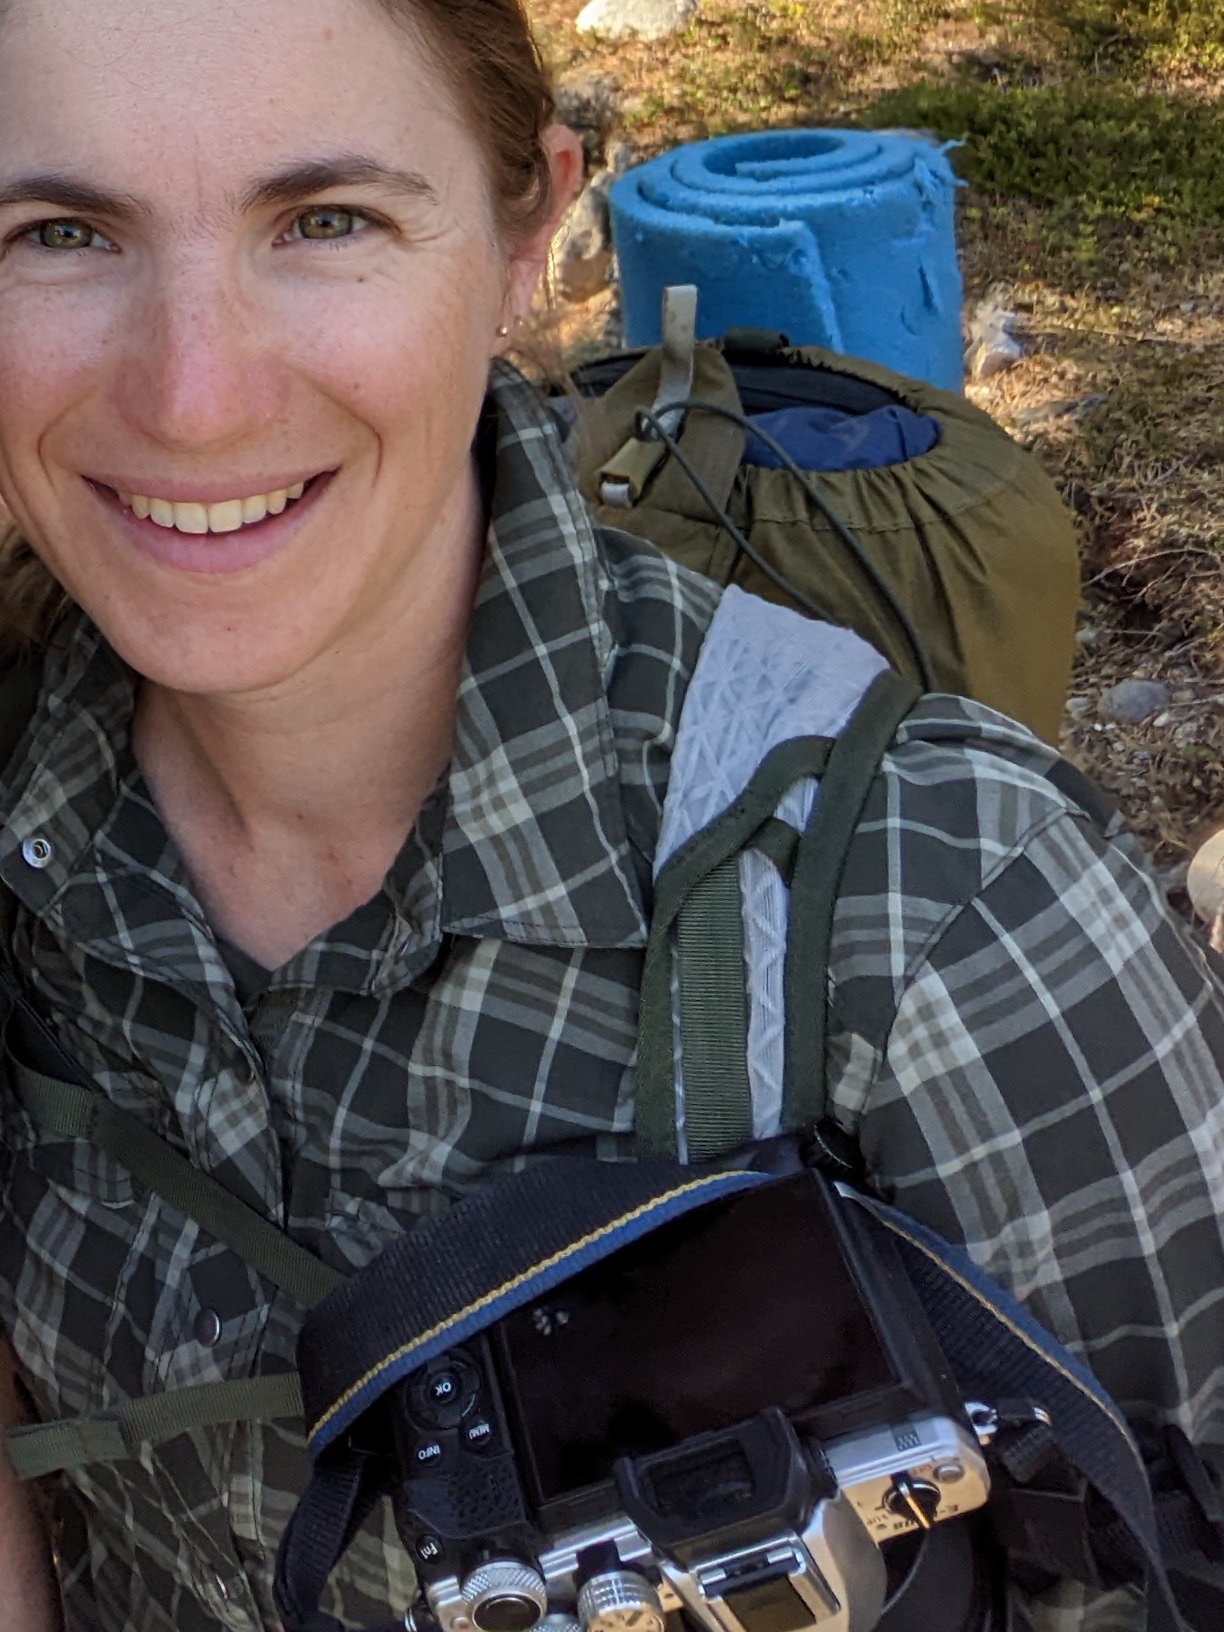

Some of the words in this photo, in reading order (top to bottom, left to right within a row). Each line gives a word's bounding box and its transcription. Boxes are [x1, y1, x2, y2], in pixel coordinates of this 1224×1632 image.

[435, 1382, 452, 1397] OK
[469, 1423, 490, 1440] MENU
[418, 1444, 441, 1460] INFO
